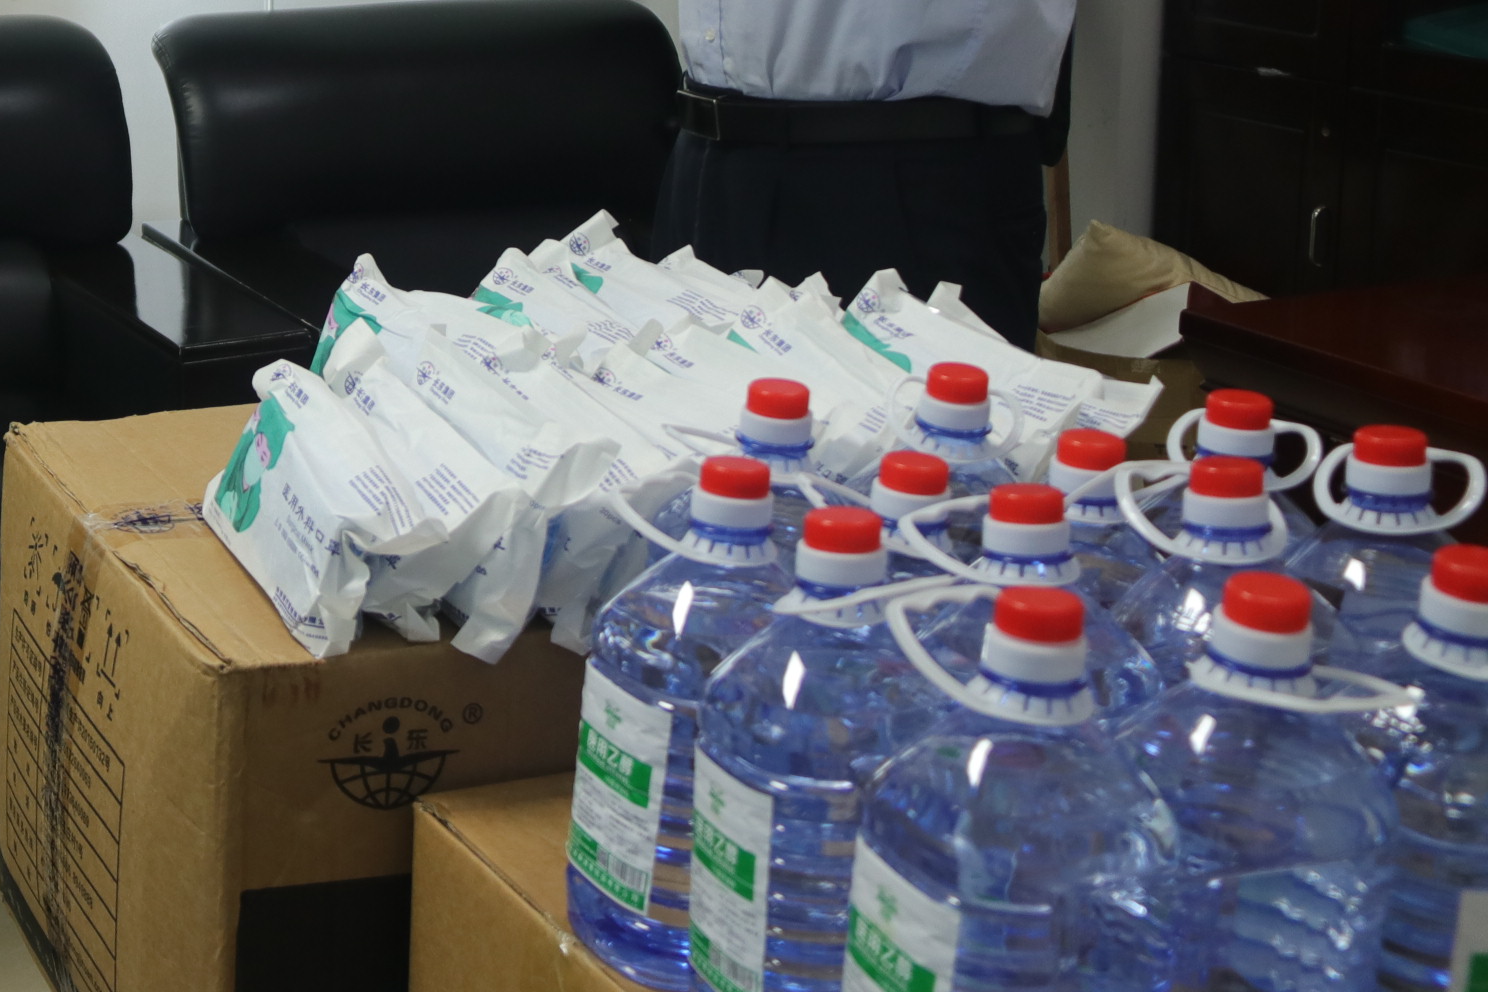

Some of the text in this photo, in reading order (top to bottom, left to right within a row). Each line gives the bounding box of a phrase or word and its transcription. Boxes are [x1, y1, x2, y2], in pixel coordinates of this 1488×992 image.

[282, 482, 341, 556] 医用外科口罩
[327, 696, 454, 742] CHANGDONG
